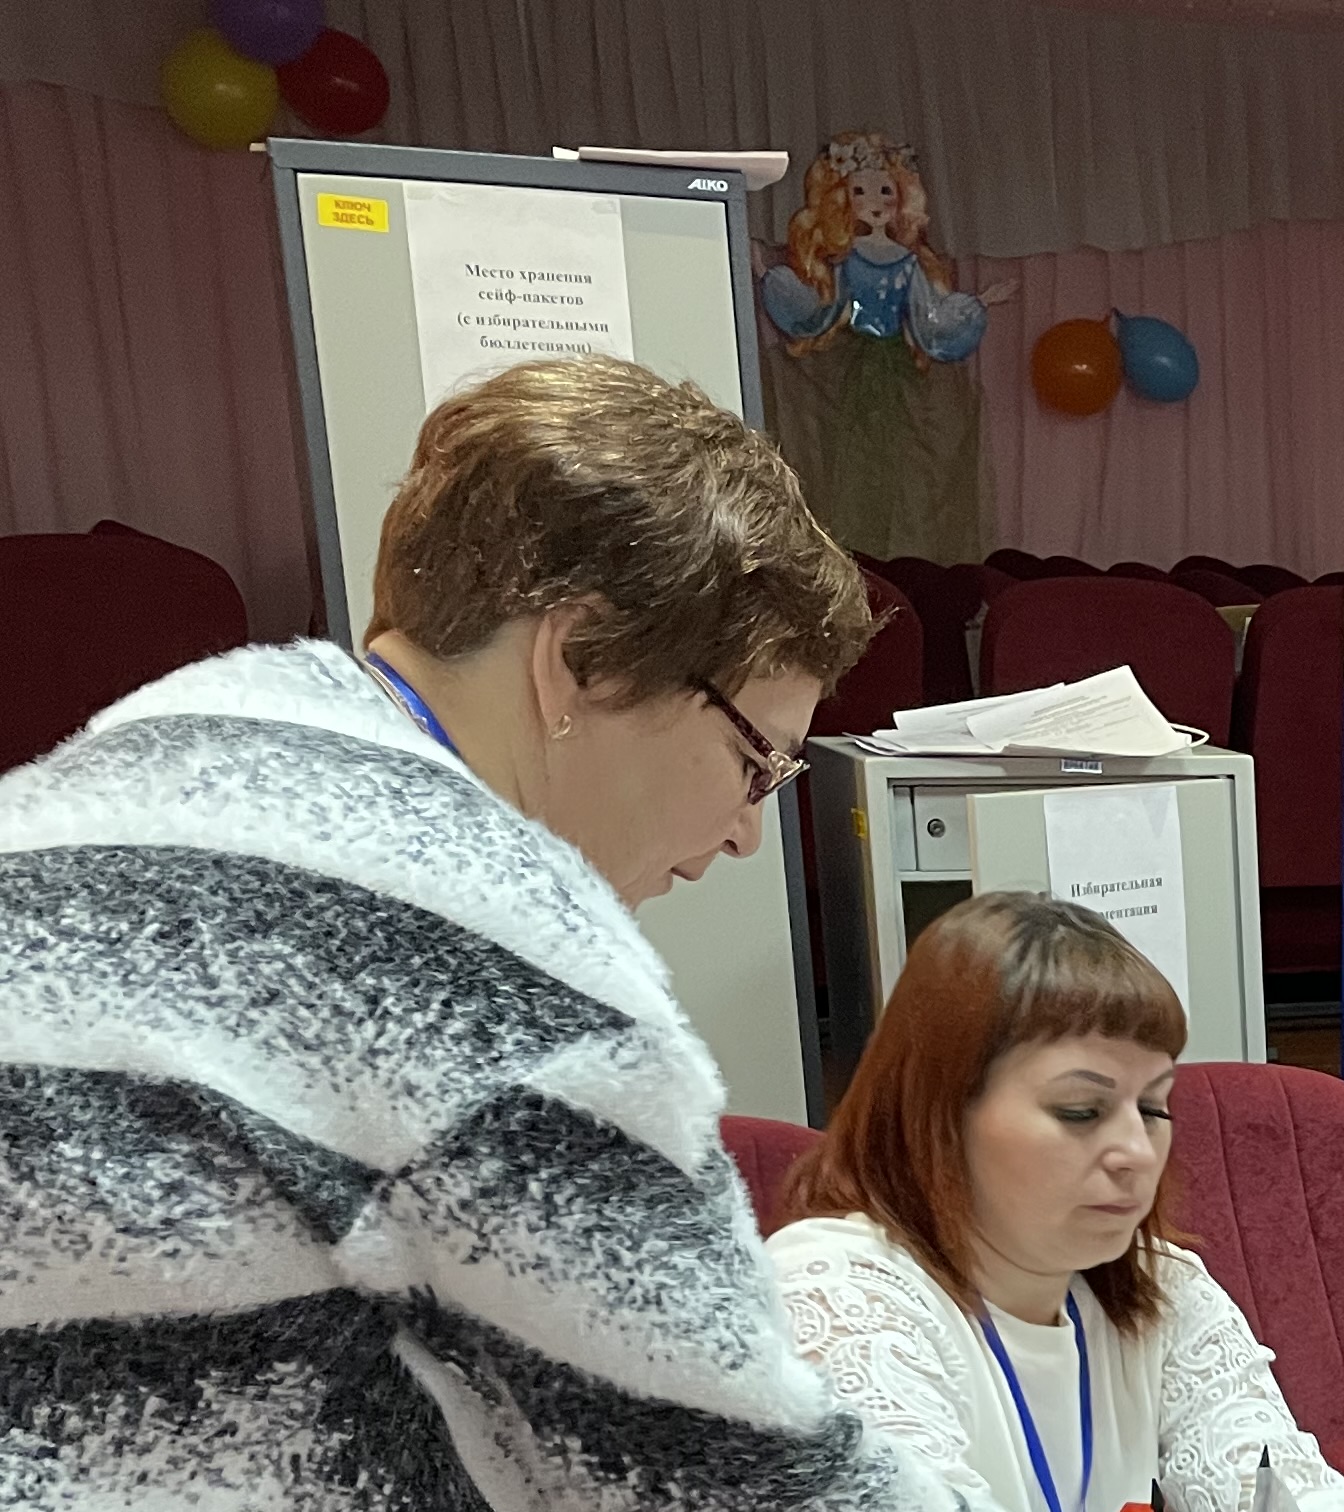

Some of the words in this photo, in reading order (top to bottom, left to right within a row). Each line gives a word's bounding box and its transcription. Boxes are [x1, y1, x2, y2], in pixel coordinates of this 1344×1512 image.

[332, 212, 374, 226] ЗДЕСЬ
[464, 263, 514, 280] Место
[519, 269, 592, 285] хранения
[478, 288, 584, 305] сейф-пакетов
[457, 311, 471, 327] (с
[475, 313, 609, 333] избирательными
[480, 335, 592, 354] бюллетенями)
[1071, 877, 1163, 898] Избирательная
[1100, 904, 1158, 920] ментация
